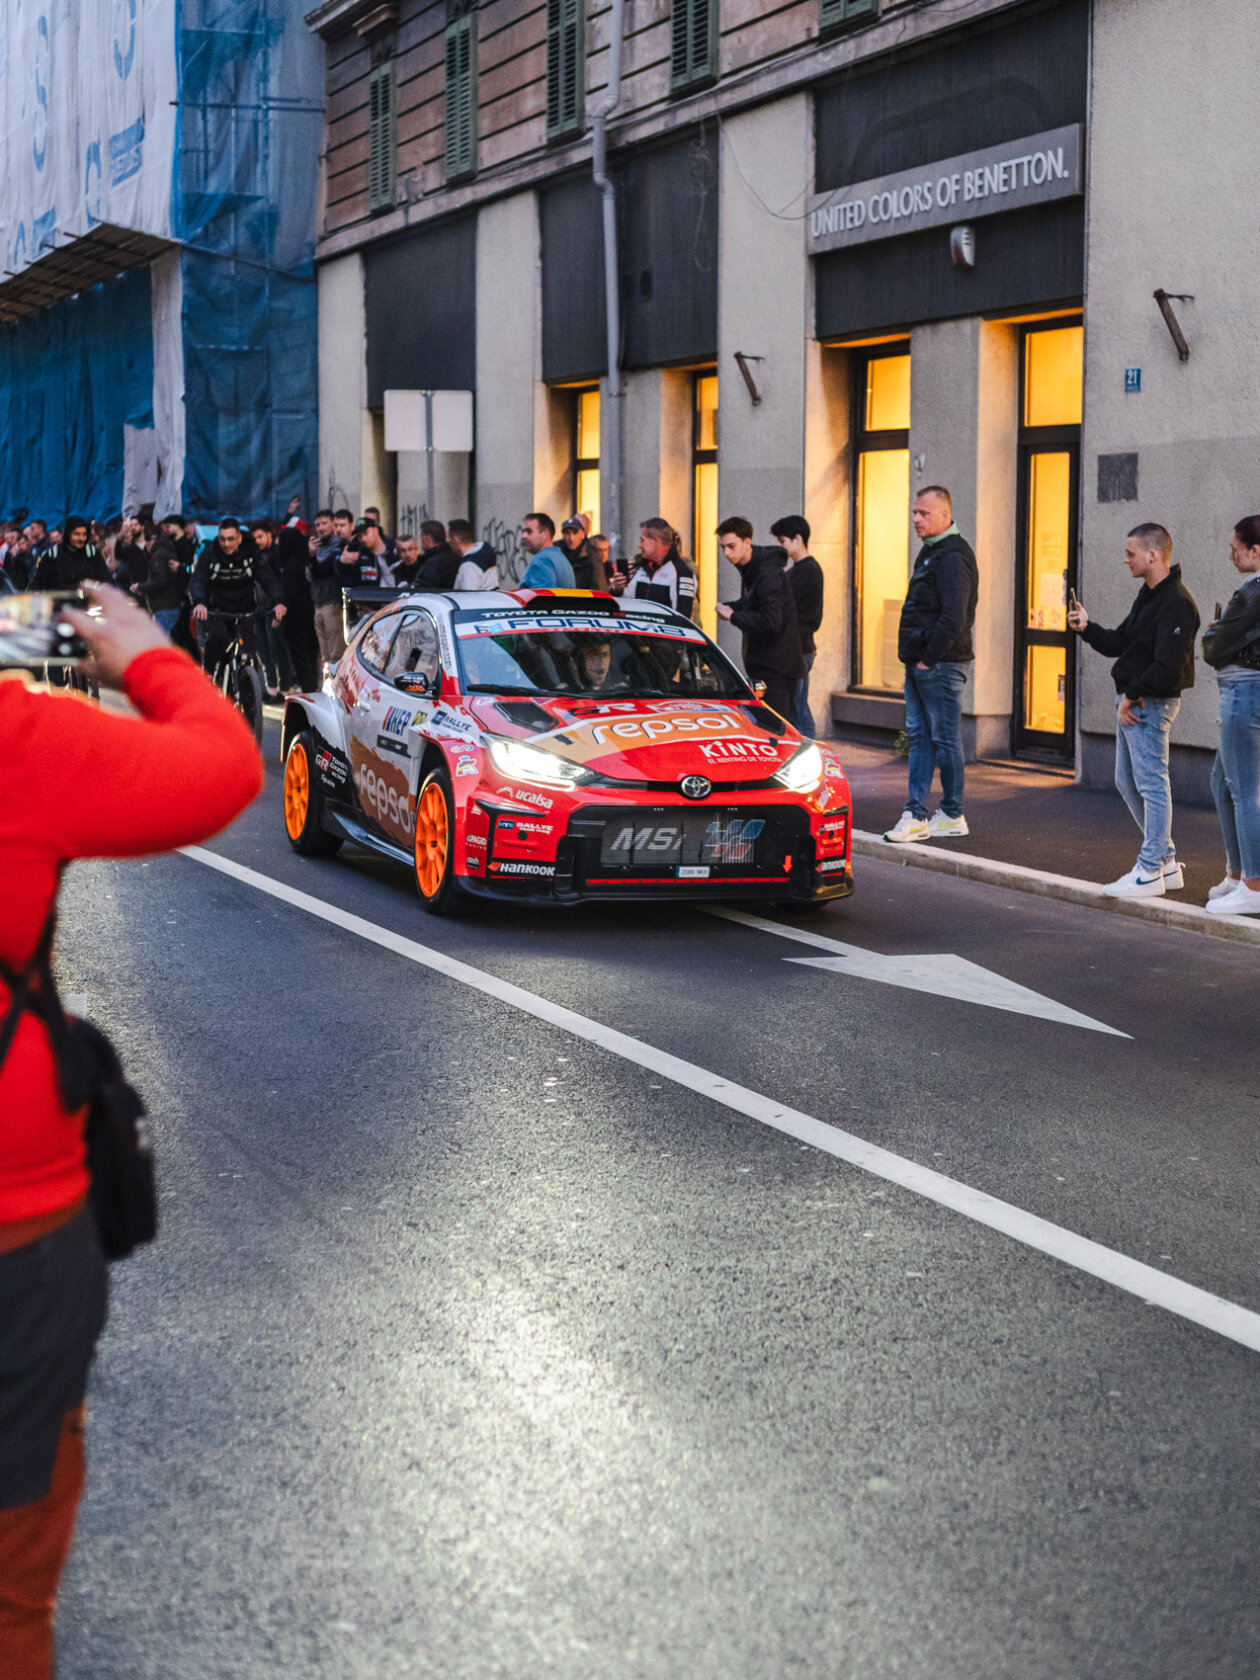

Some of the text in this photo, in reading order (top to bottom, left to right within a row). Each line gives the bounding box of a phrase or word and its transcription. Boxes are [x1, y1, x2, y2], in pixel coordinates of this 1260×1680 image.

[811, 148, 1069, 237] UNITED COLORS OF BENETTON.
[1127, 369, 1137, 384] 21
[482, 609, 548, 618] TOYOTA
[552, 609, 610, 617] GAZOO
[507, 618, 686, 637] FORUM8
[569, 703, 637, 716] GR
[444, 714, 472, 731] RALLYE
[592, 714, 740, 745] repsol
[698, 740, 778, 757] KINTO
[316, 754, 329, 772] GR
[321, 774, 335, 788] Spain
[516, 789, 554, 809] ucalsa
[516, 821, 554, 832] RALLYE
